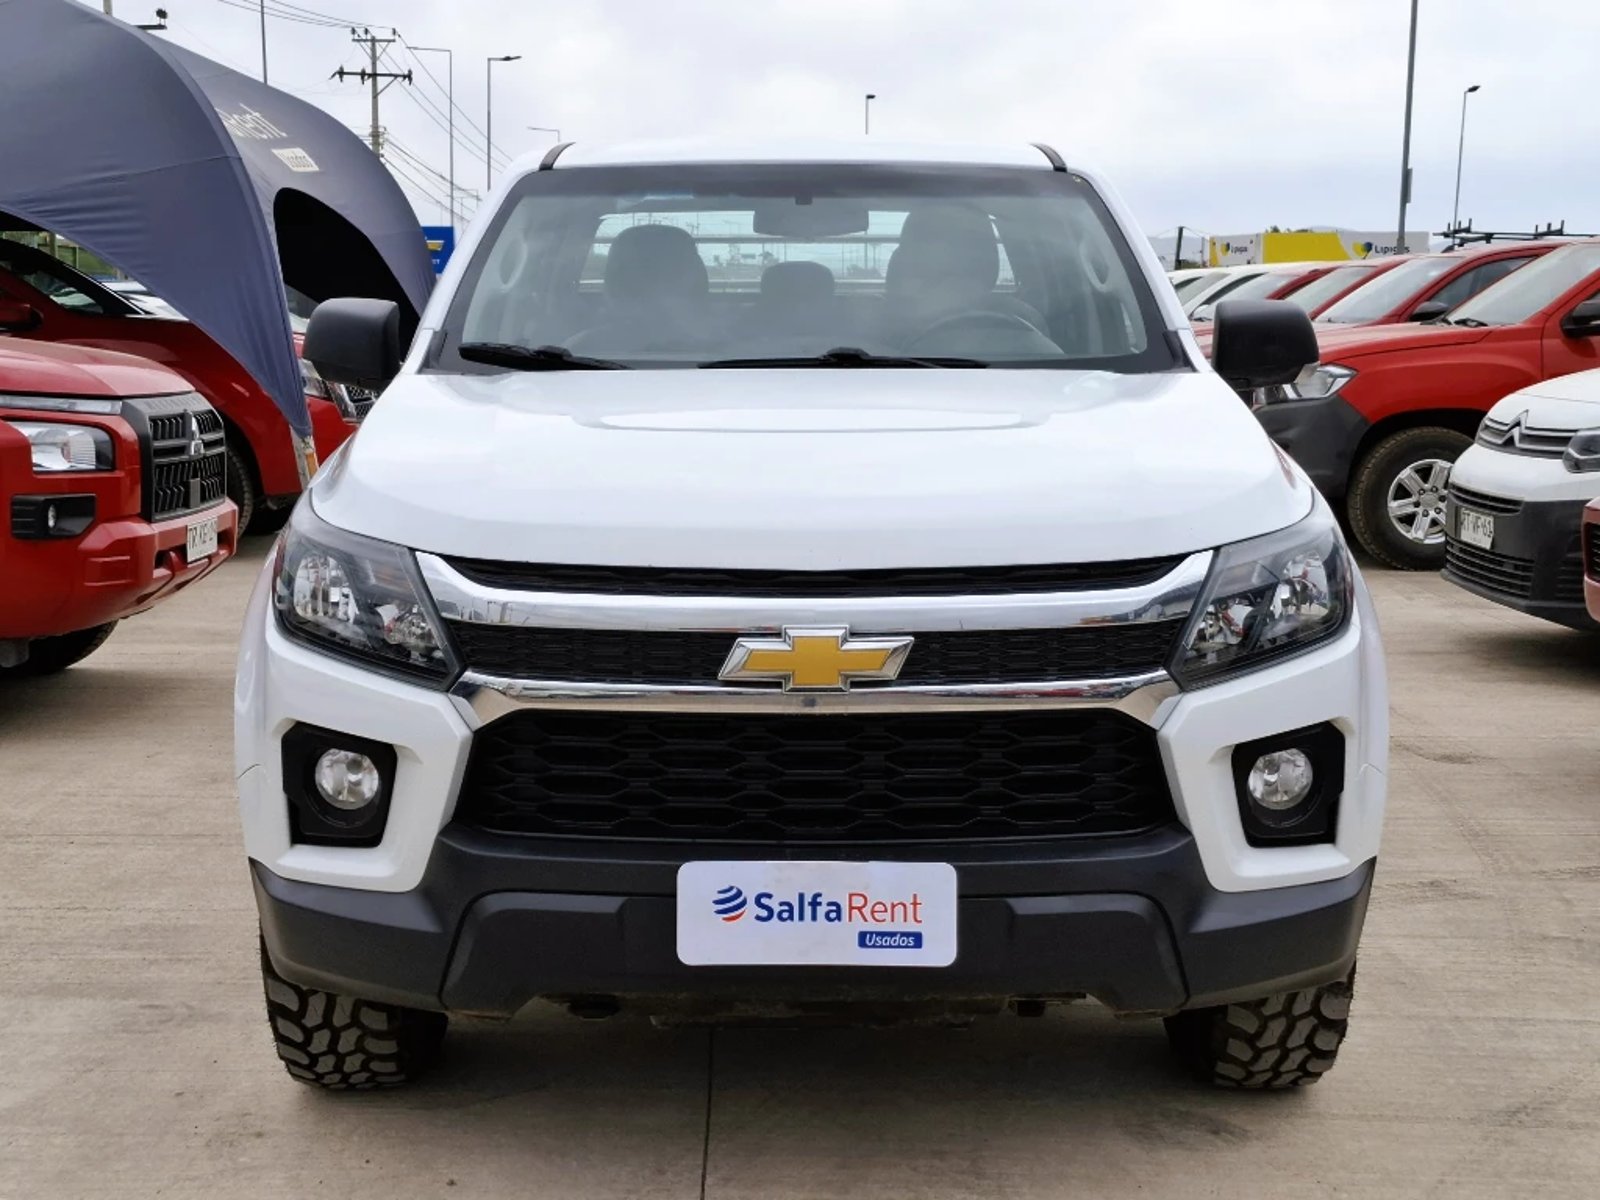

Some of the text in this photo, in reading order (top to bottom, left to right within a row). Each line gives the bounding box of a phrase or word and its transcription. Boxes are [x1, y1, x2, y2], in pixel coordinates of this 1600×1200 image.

[1374, 244, 1410, 255] Lipigs
[753, 891, 922, 923] SalfaRent
[864, 932, 915, 946] Usados
